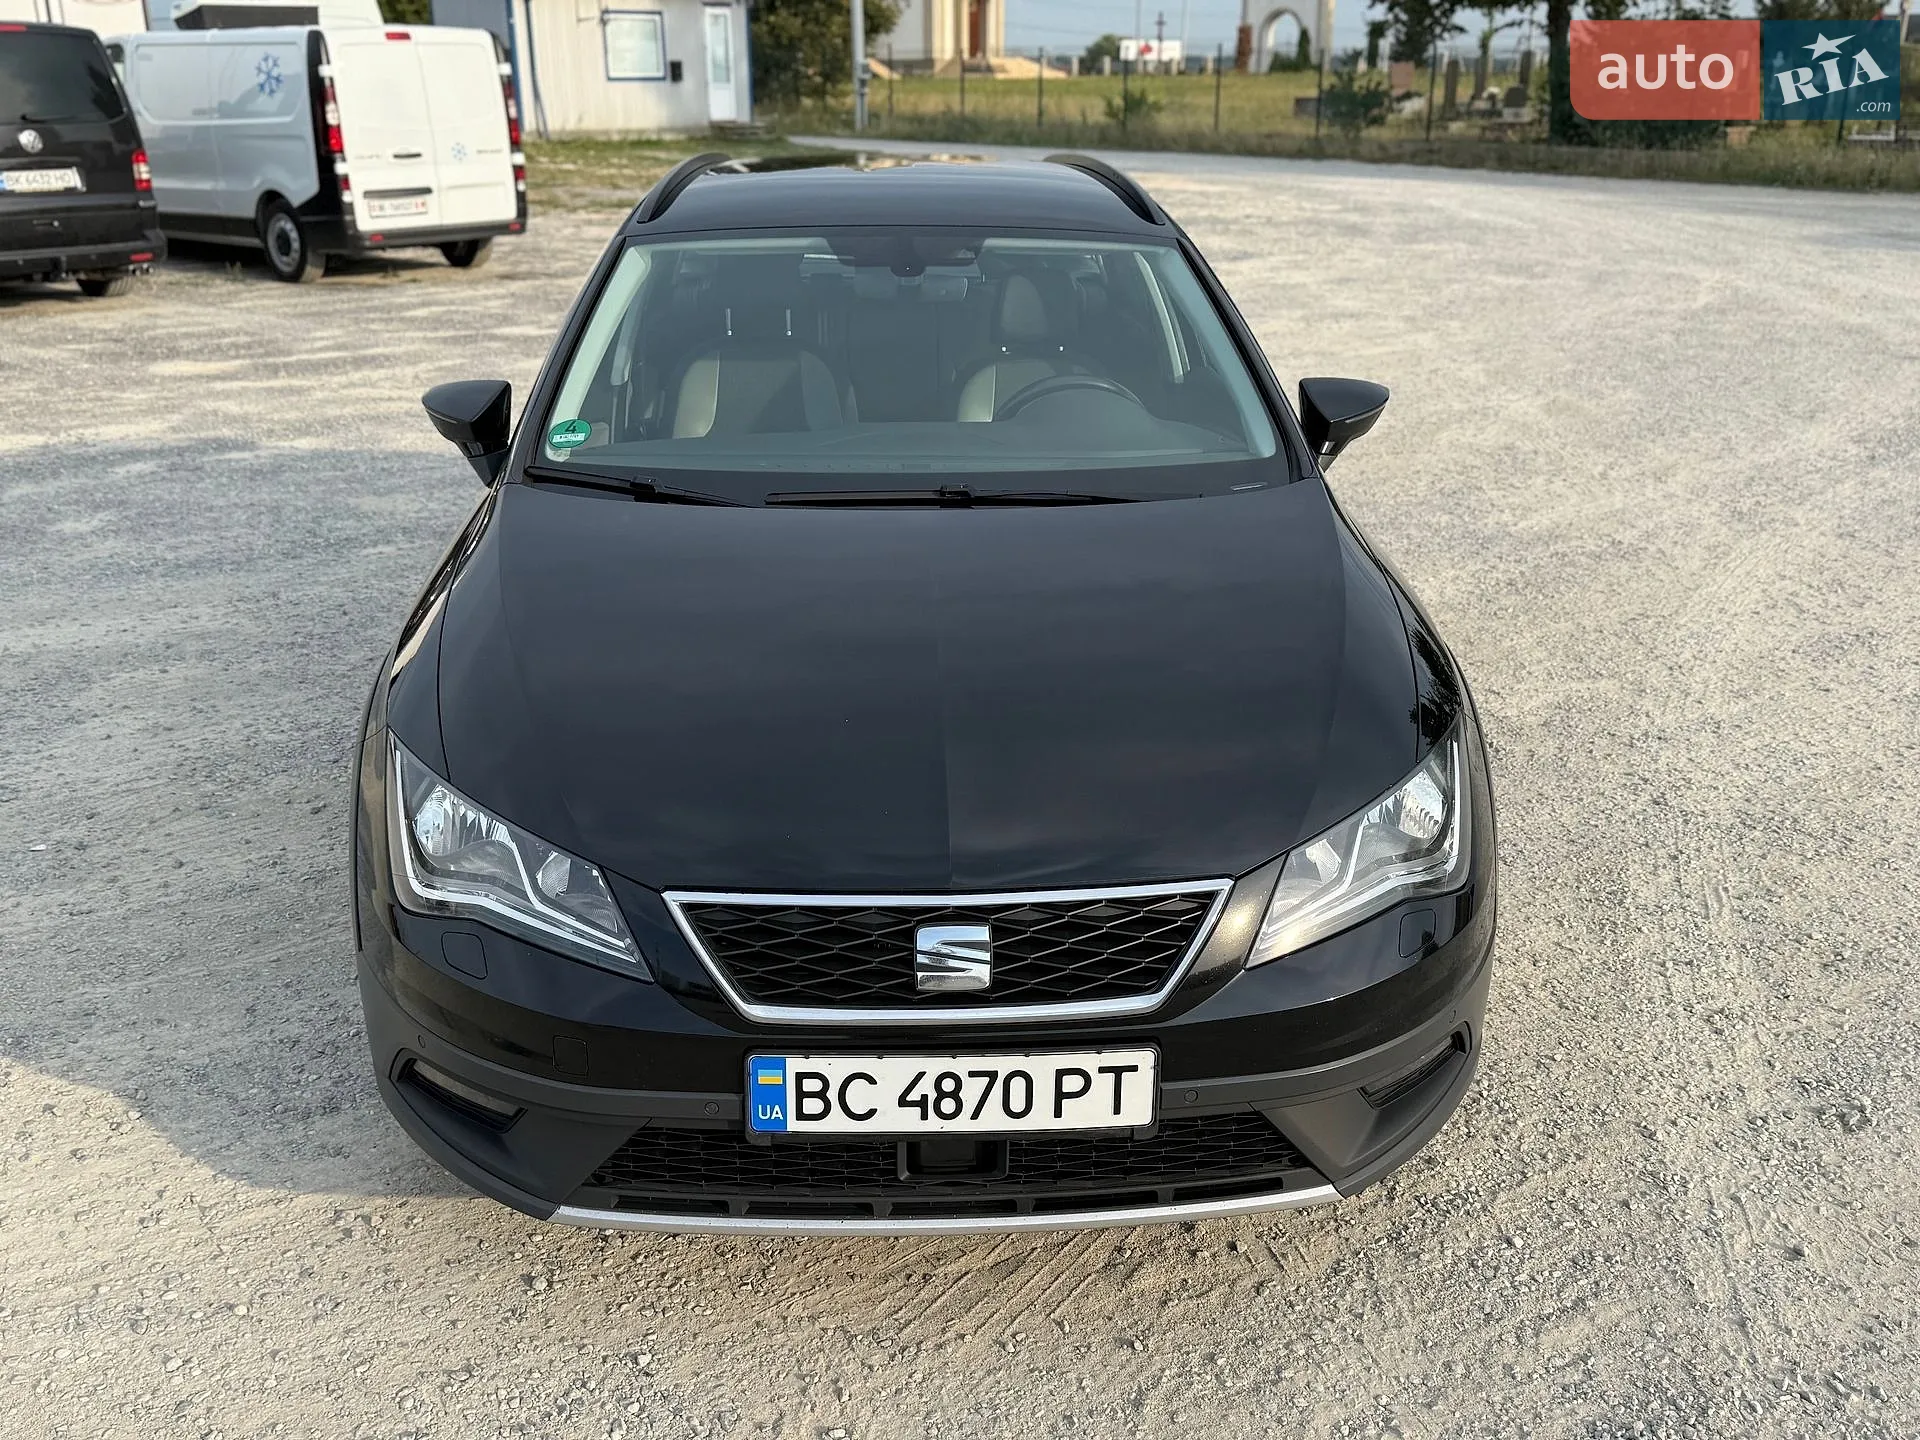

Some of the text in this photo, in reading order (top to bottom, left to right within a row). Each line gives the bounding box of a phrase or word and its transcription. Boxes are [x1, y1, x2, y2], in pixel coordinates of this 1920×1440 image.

[565, 420, 576, 433] 4
[795, 1065, 1139, 1121] BC 4870 PT
[758, 1104, 784, 1120] UA
